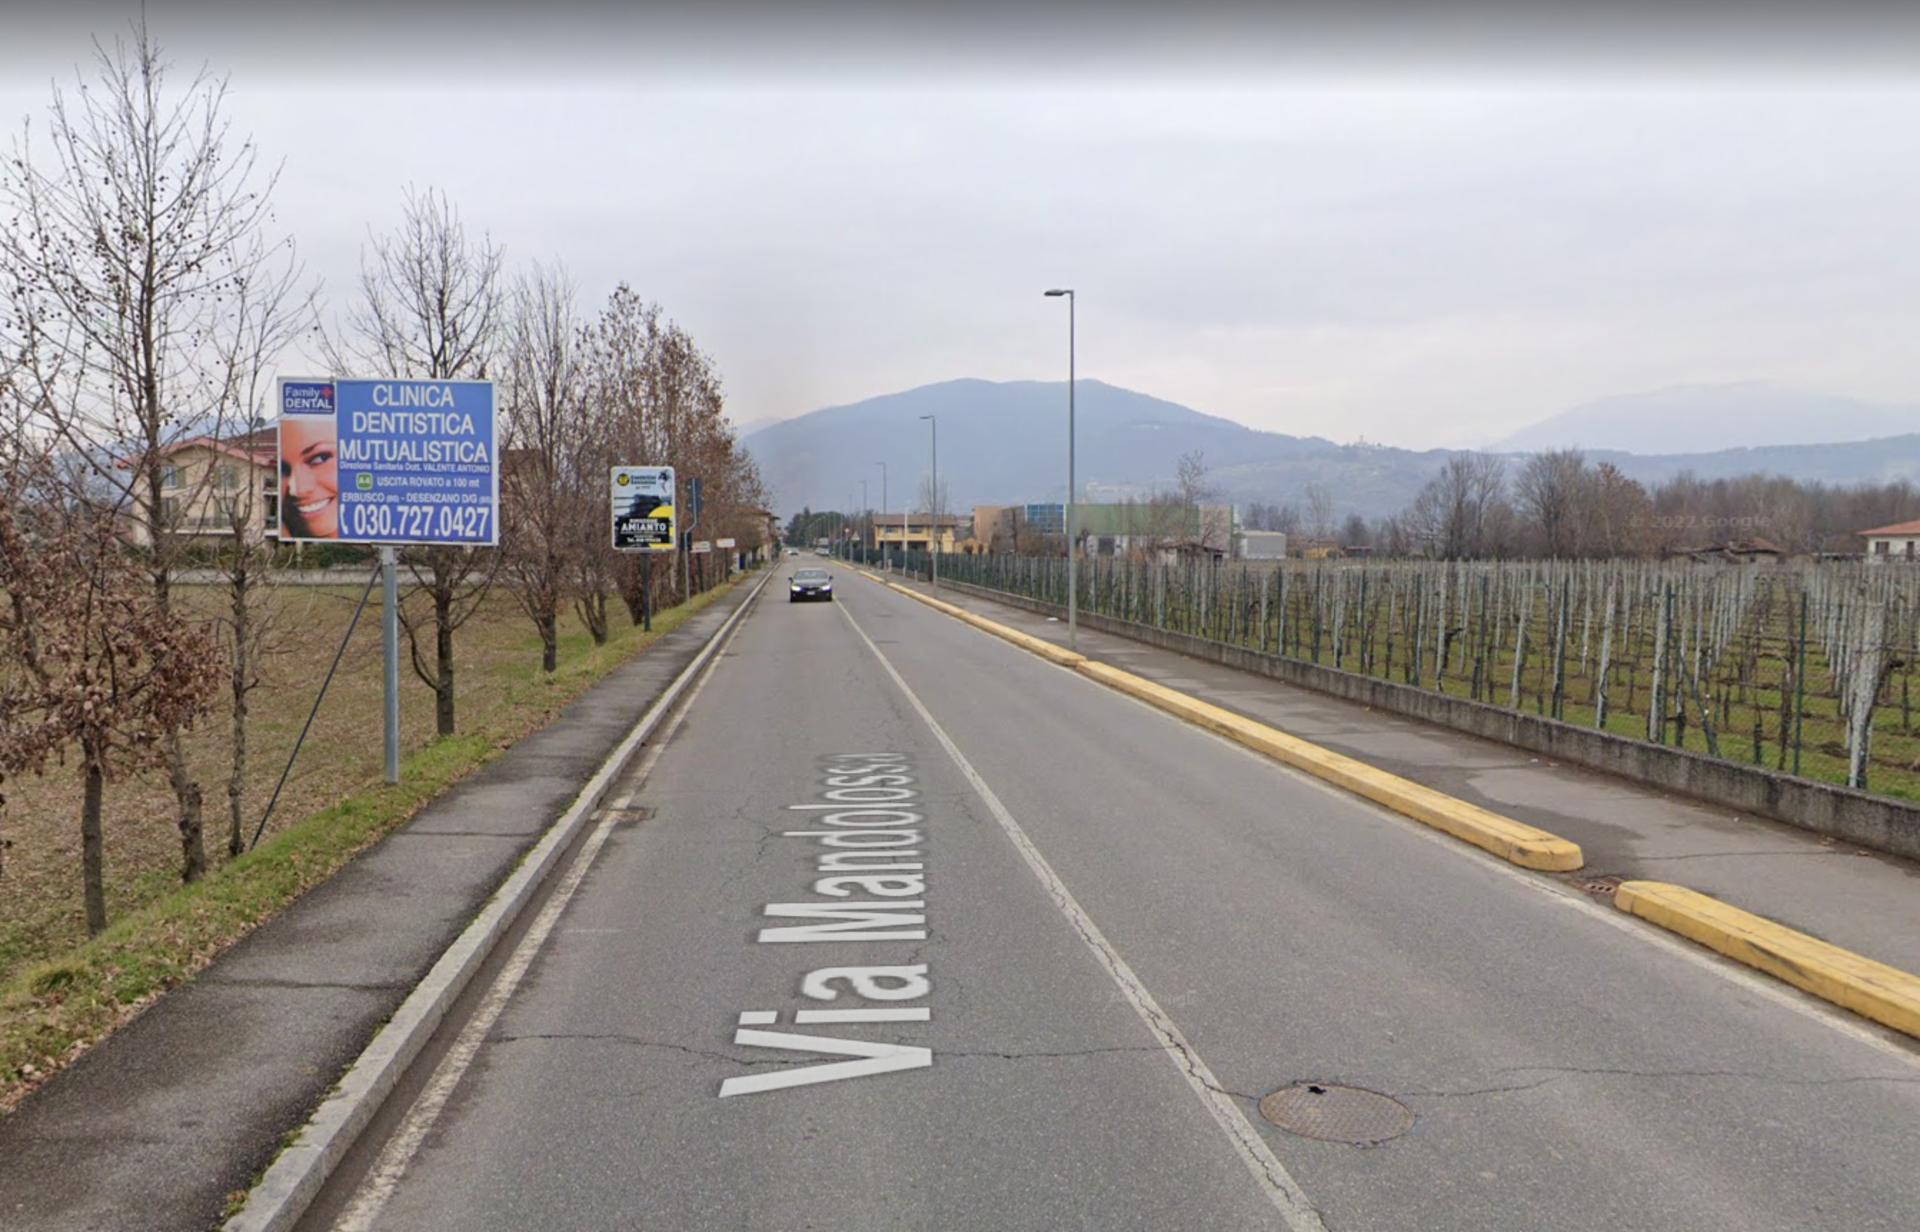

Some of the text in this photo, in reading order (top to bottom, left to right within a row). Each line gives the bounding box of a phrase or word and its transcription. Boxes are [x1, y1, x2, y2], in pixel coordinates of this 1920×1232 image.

[285, 386, 320, 398] Family
[373, 384, 455, 407] CLINICA
[285, 398, 333, 409] DENTAL
[352, 412, 475, 435] DENTISTICA
[340, 439, 489, 463] MUTUALISTICA
[423, 464, 456, 472] VALENTE
[457, 464, 490, 473] ANTONIO
[377, 478, 409, 487] USCITA
[410, 478, 444, 487] ROVATO
[445, 479, 452, 487] a
[453, 478, 467, 487] 100
[342, 492, 385, 502] ERBUSCO
[406, 493, 459, 503] DESENZANO
[355, 505, 489, 537] 030.727.0427
[622, 523, 666, 531] AMIANTO
